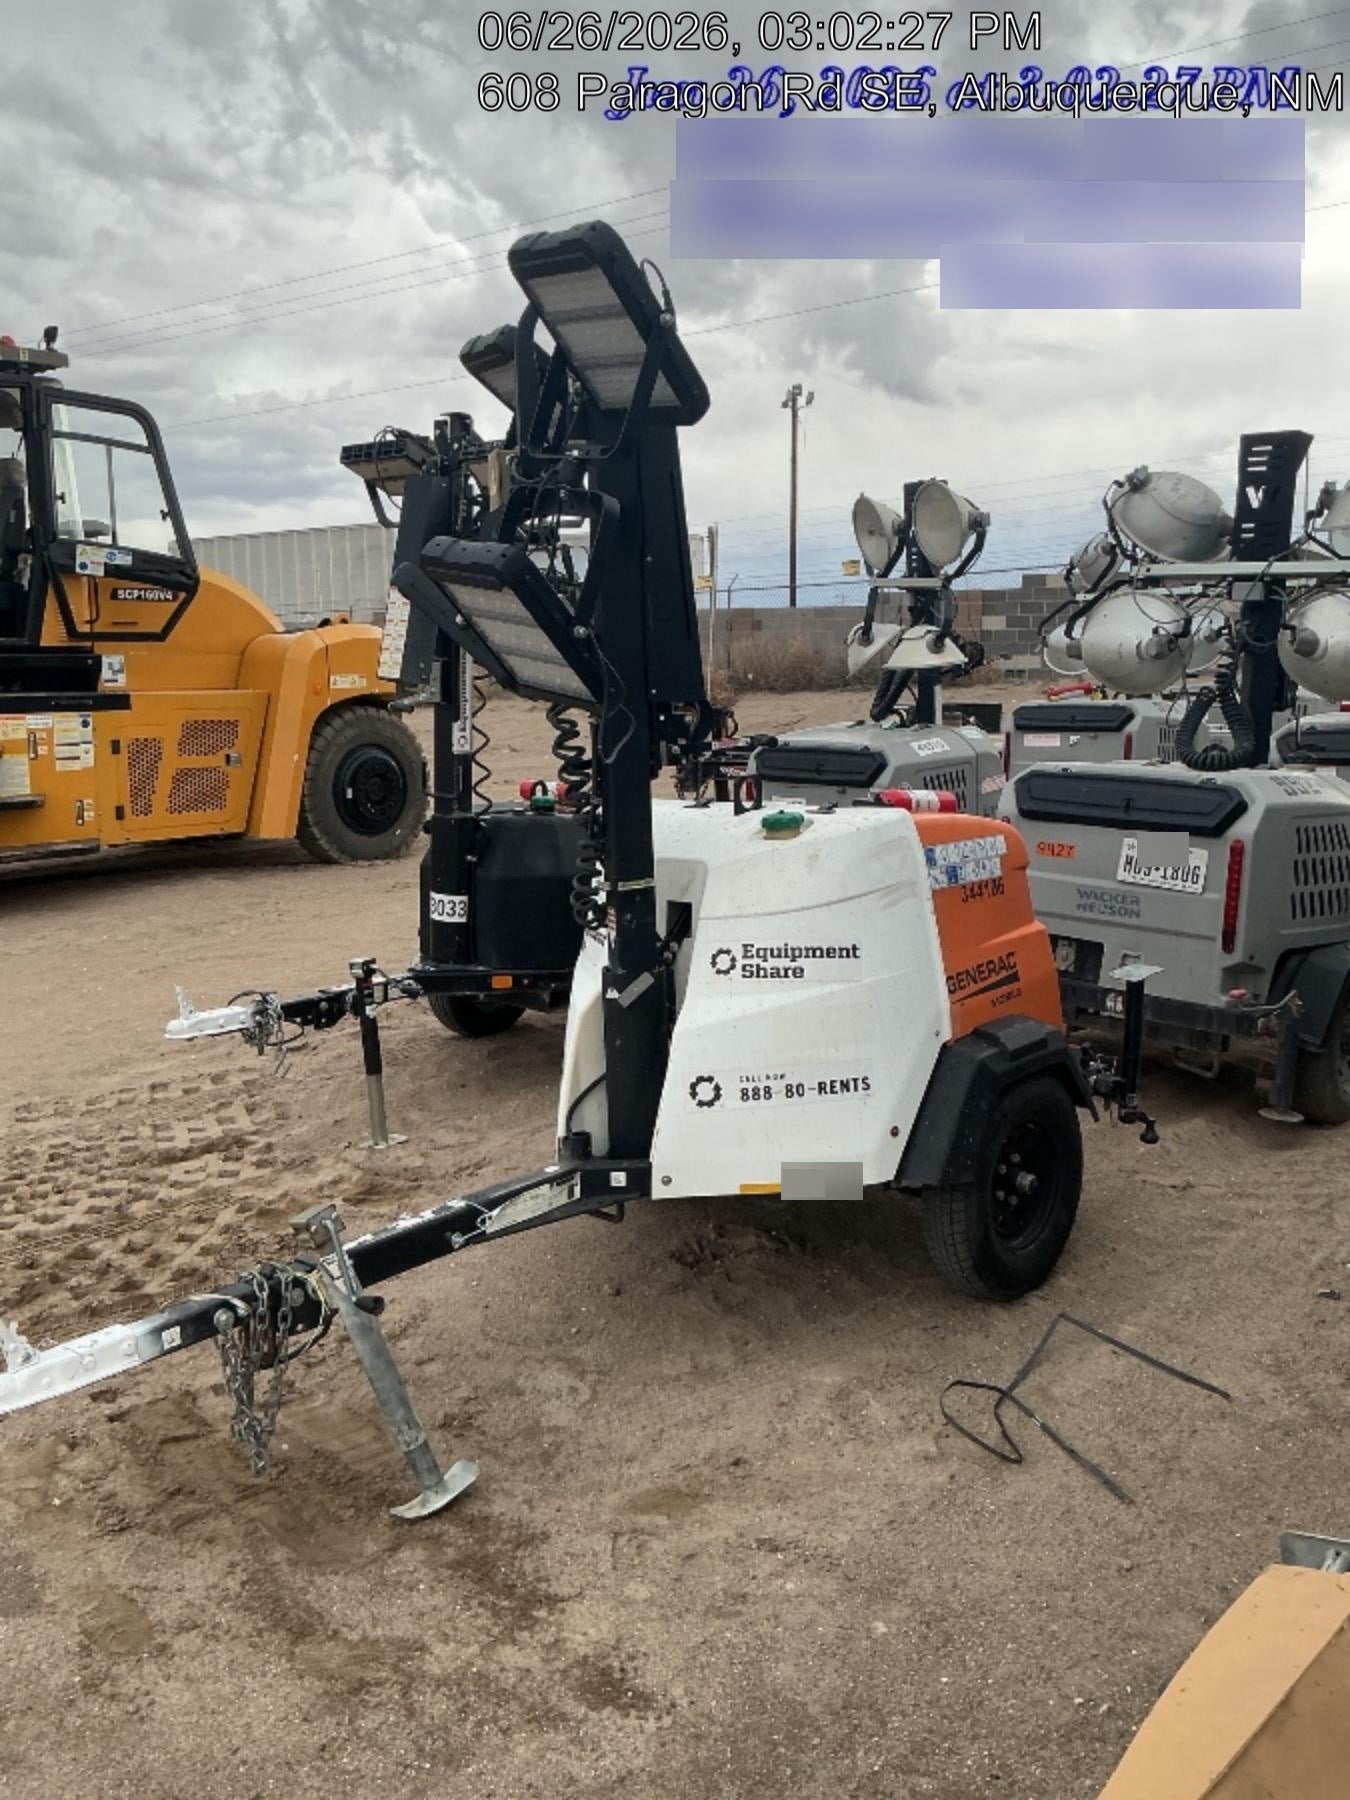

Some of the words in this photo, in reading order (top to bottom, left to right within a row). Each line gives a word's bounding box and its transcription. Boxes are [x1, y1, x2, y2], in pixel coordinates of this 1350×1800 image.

[741, 942, 861, 963] Equipment
[741, 963, 805, 979] Share
[946, 951, 1017, 995] GENERAC
